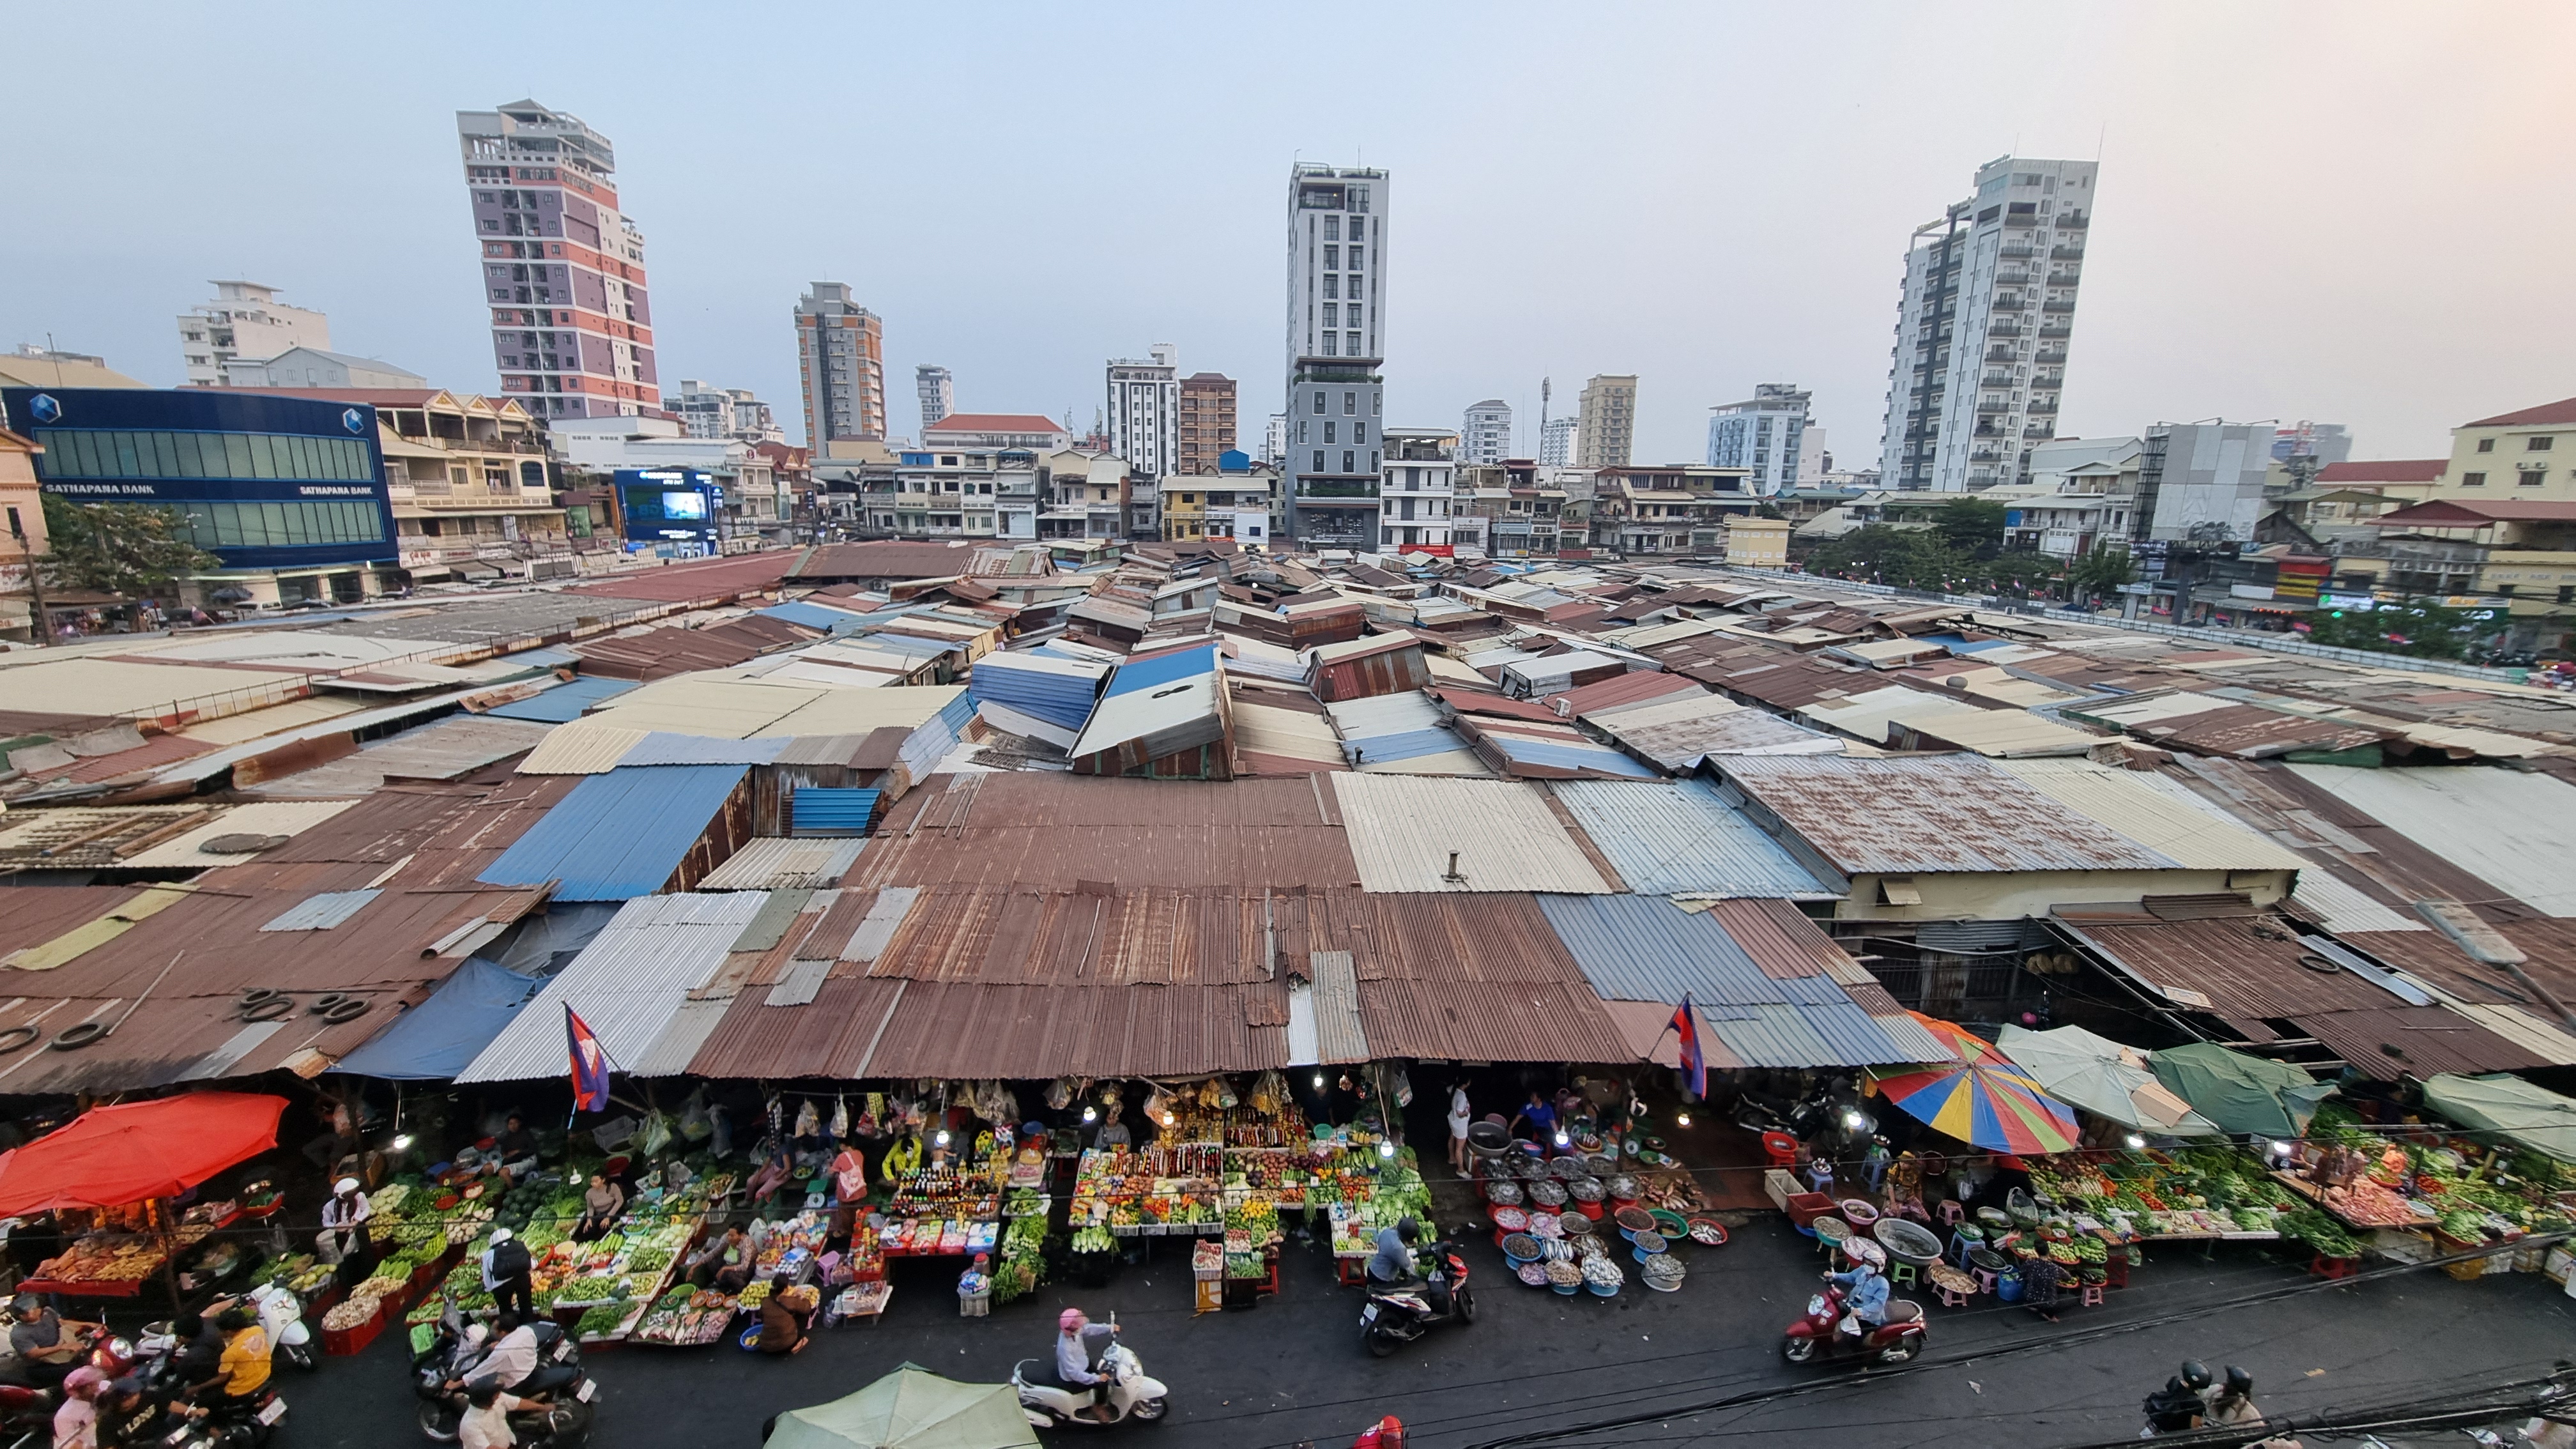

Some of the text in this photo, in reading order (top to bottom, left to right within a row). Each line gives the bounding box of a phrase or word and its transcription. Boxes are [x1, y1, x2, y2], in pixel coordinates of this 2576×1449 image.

[46, 484, 155, 494] SATHAPANA BANK
[300, 486, 350, 495] SATHAPANA
